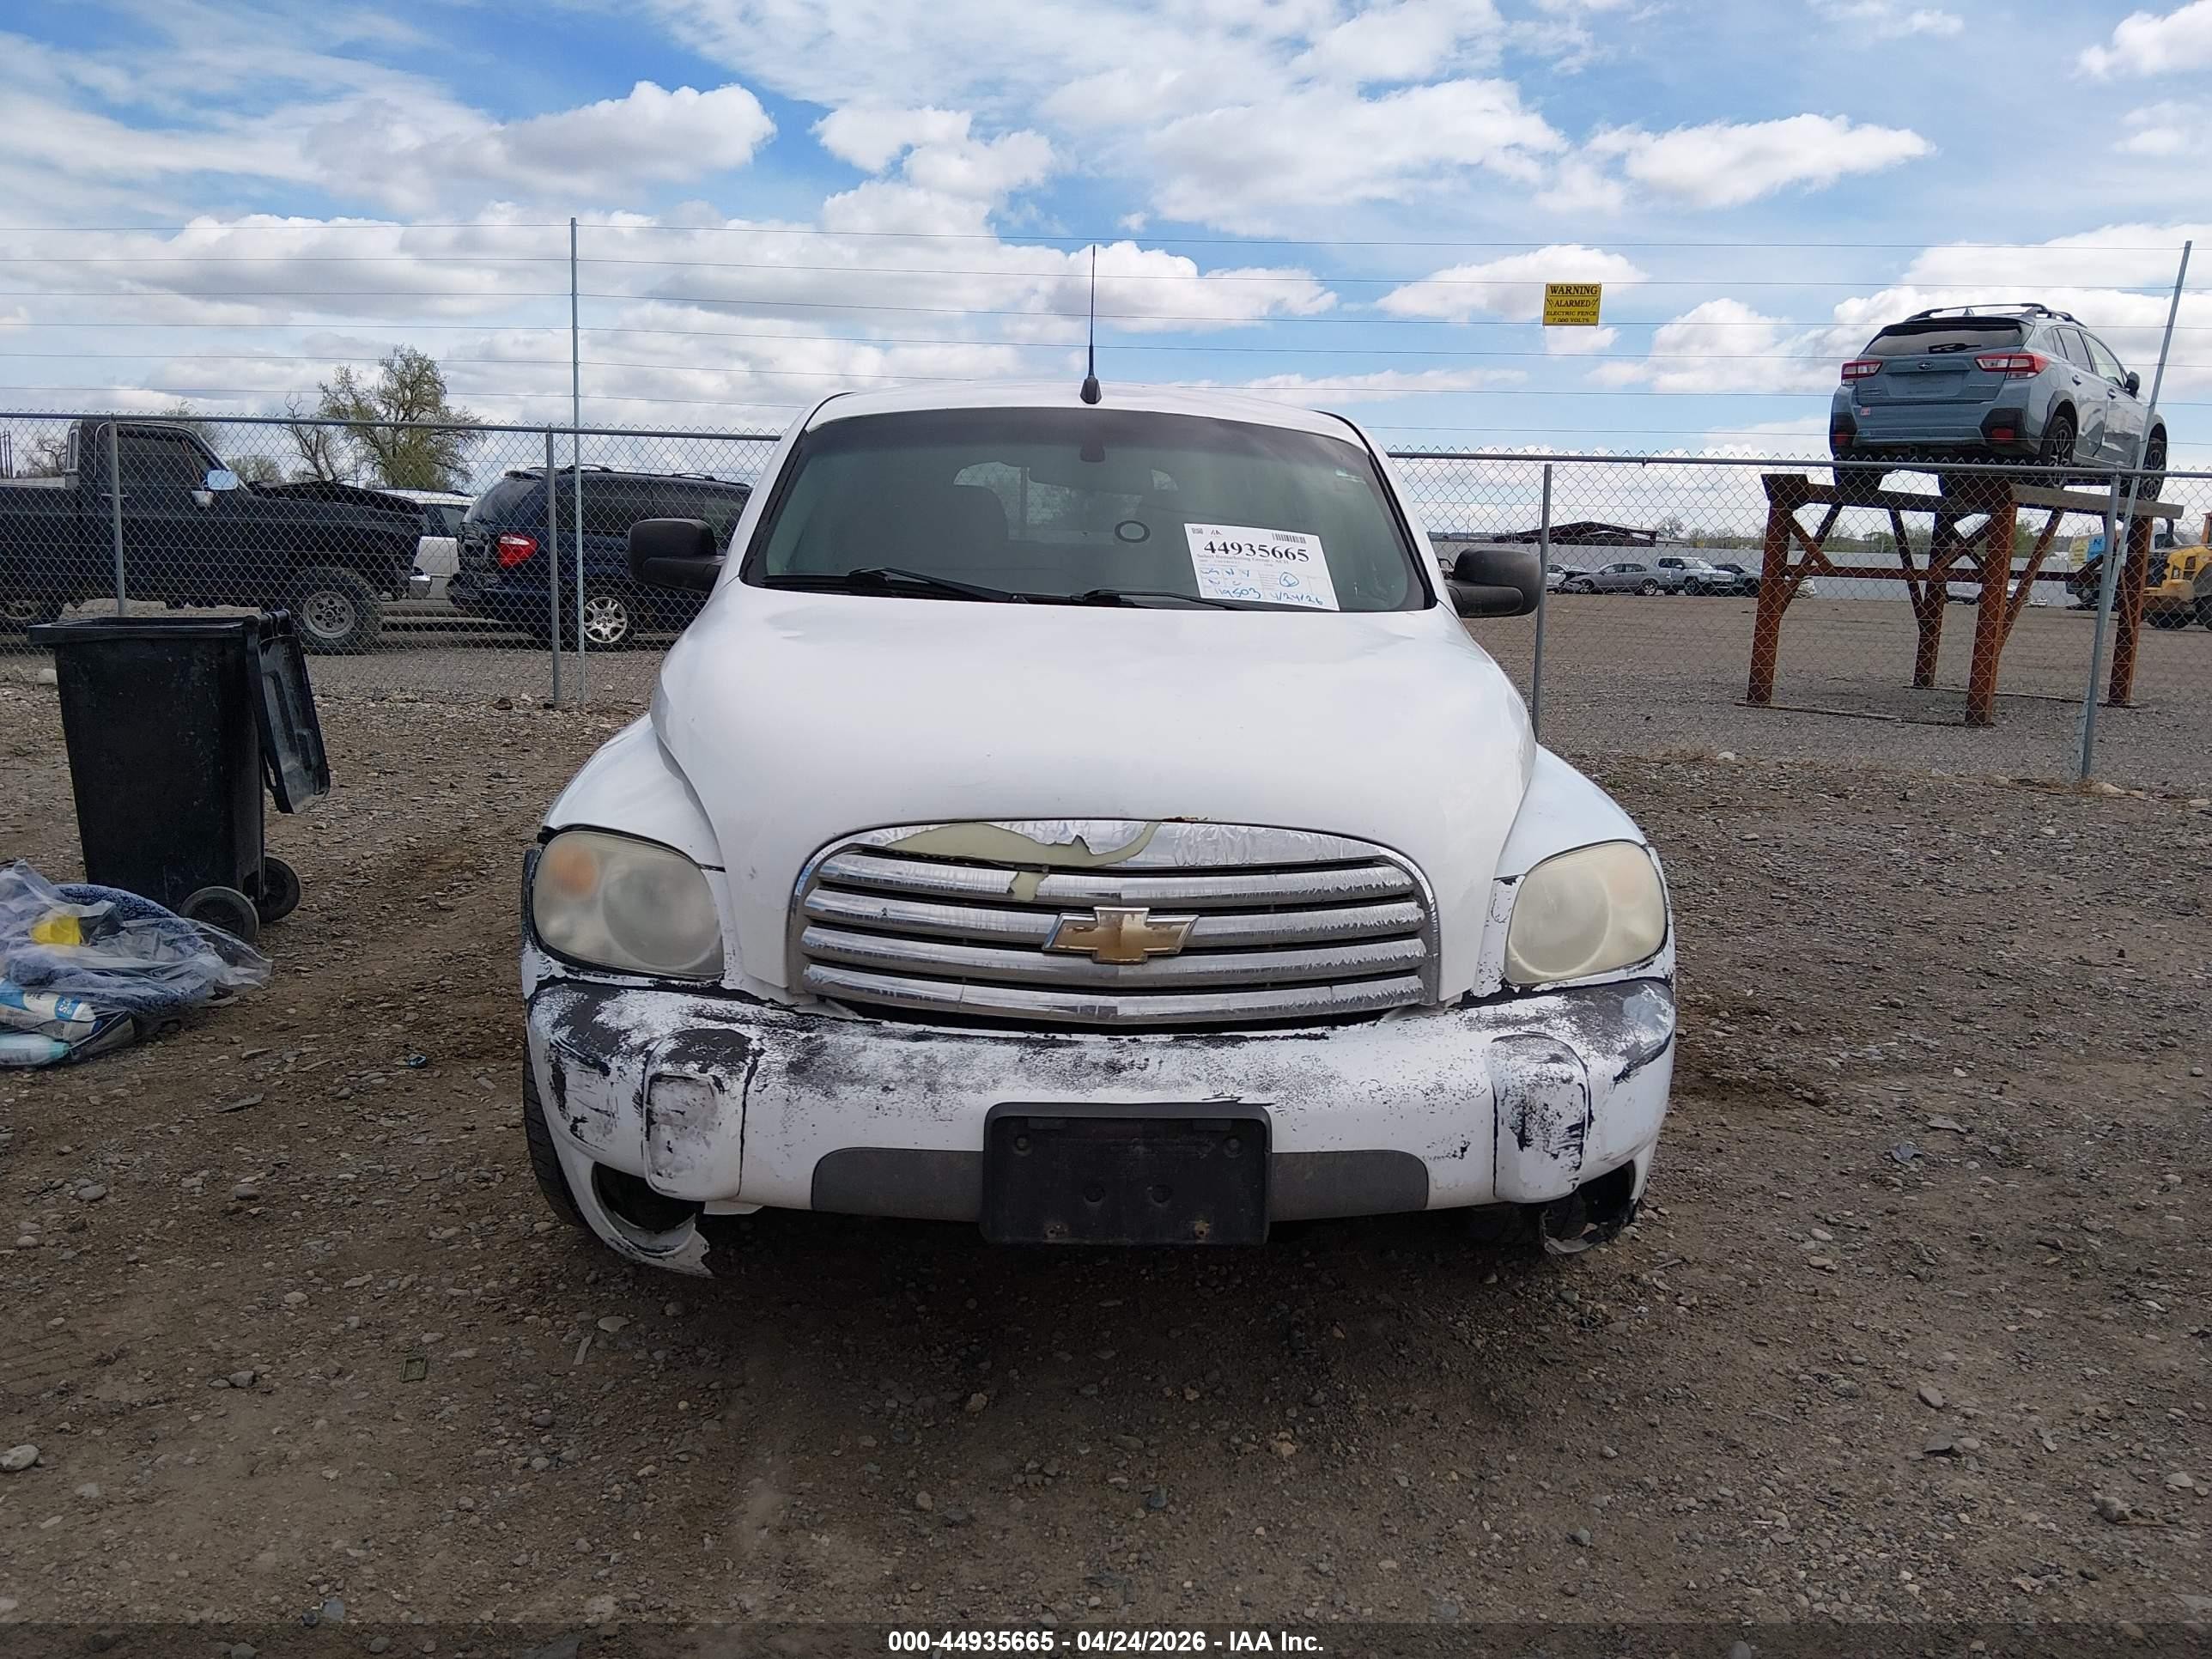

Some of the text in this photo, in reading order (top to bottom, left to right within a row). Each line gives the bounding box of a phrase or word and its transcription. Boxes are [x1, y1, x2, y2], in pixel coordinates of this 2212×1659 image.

[1550, 285, 1598, 295] WARNING
[1554, 299, 1590, 307] ALARMED
[1204, 540, 1310, 562] 44935665
